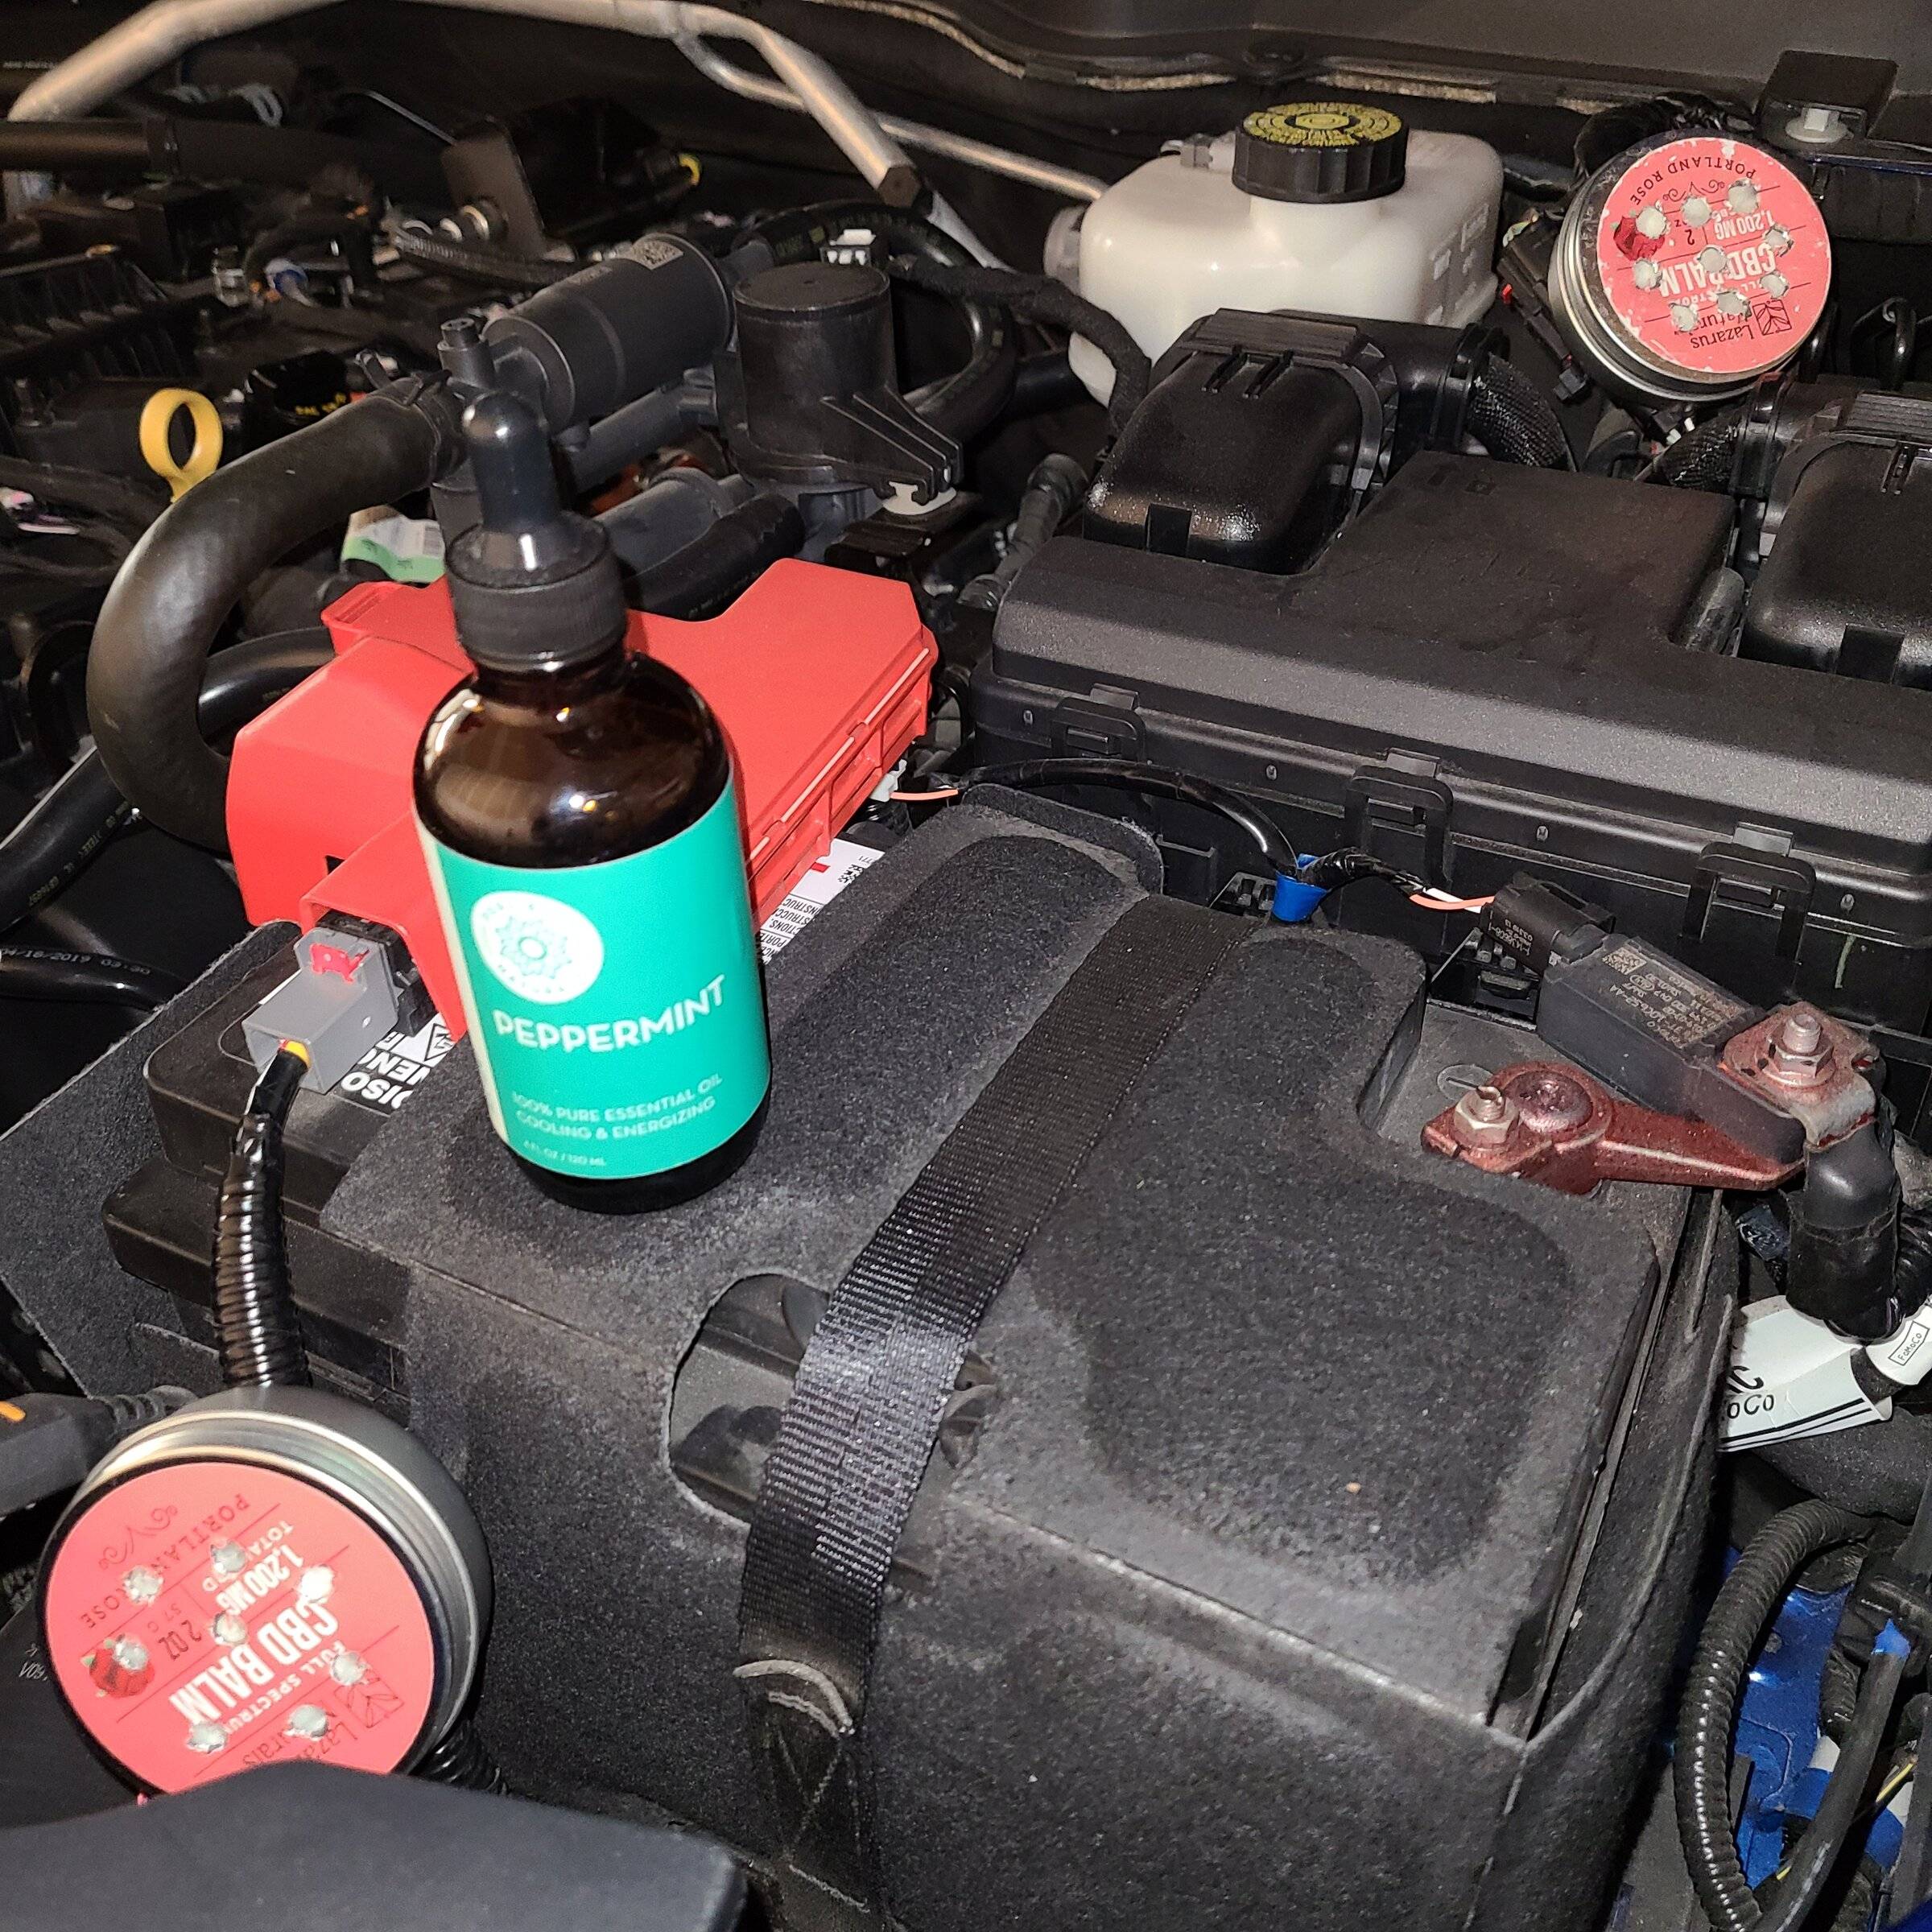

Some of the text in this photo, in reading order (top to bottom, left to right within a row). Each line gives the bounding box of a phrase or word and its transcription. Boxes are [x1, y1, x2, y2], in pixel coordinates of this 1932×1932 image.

[1630, 156, 1756, 205] PORTLAND ROSE
[1686, 229, 1695, 246] 2
[1715, 209, 1775, 240] 1,200 MG
[1728, 243, 1777, 280] CBD
[1690, 324, 1753, 349] Lazarus
[492, 974, 725, 1052] PEPPERMINT
[515, 1095, 716, 1141] COOLING & ENERGIZING
[555, 1106, 601, 1123] PURE
[604, 1088, 696, 1122] ESSENTIAL
[696, 1073, 724, 1095] OIL
[1727, 1394, 1775, 1419] oCo
[149, 1494, 250, 1575] PORTLAN
[244, 1544, 304, 1597] 1,200
[215, 1580, 257, 1616] MG
[158, 1620, 202, 1662] 2 OZ
[168, 1598, 339, 1724] CBD BALM
